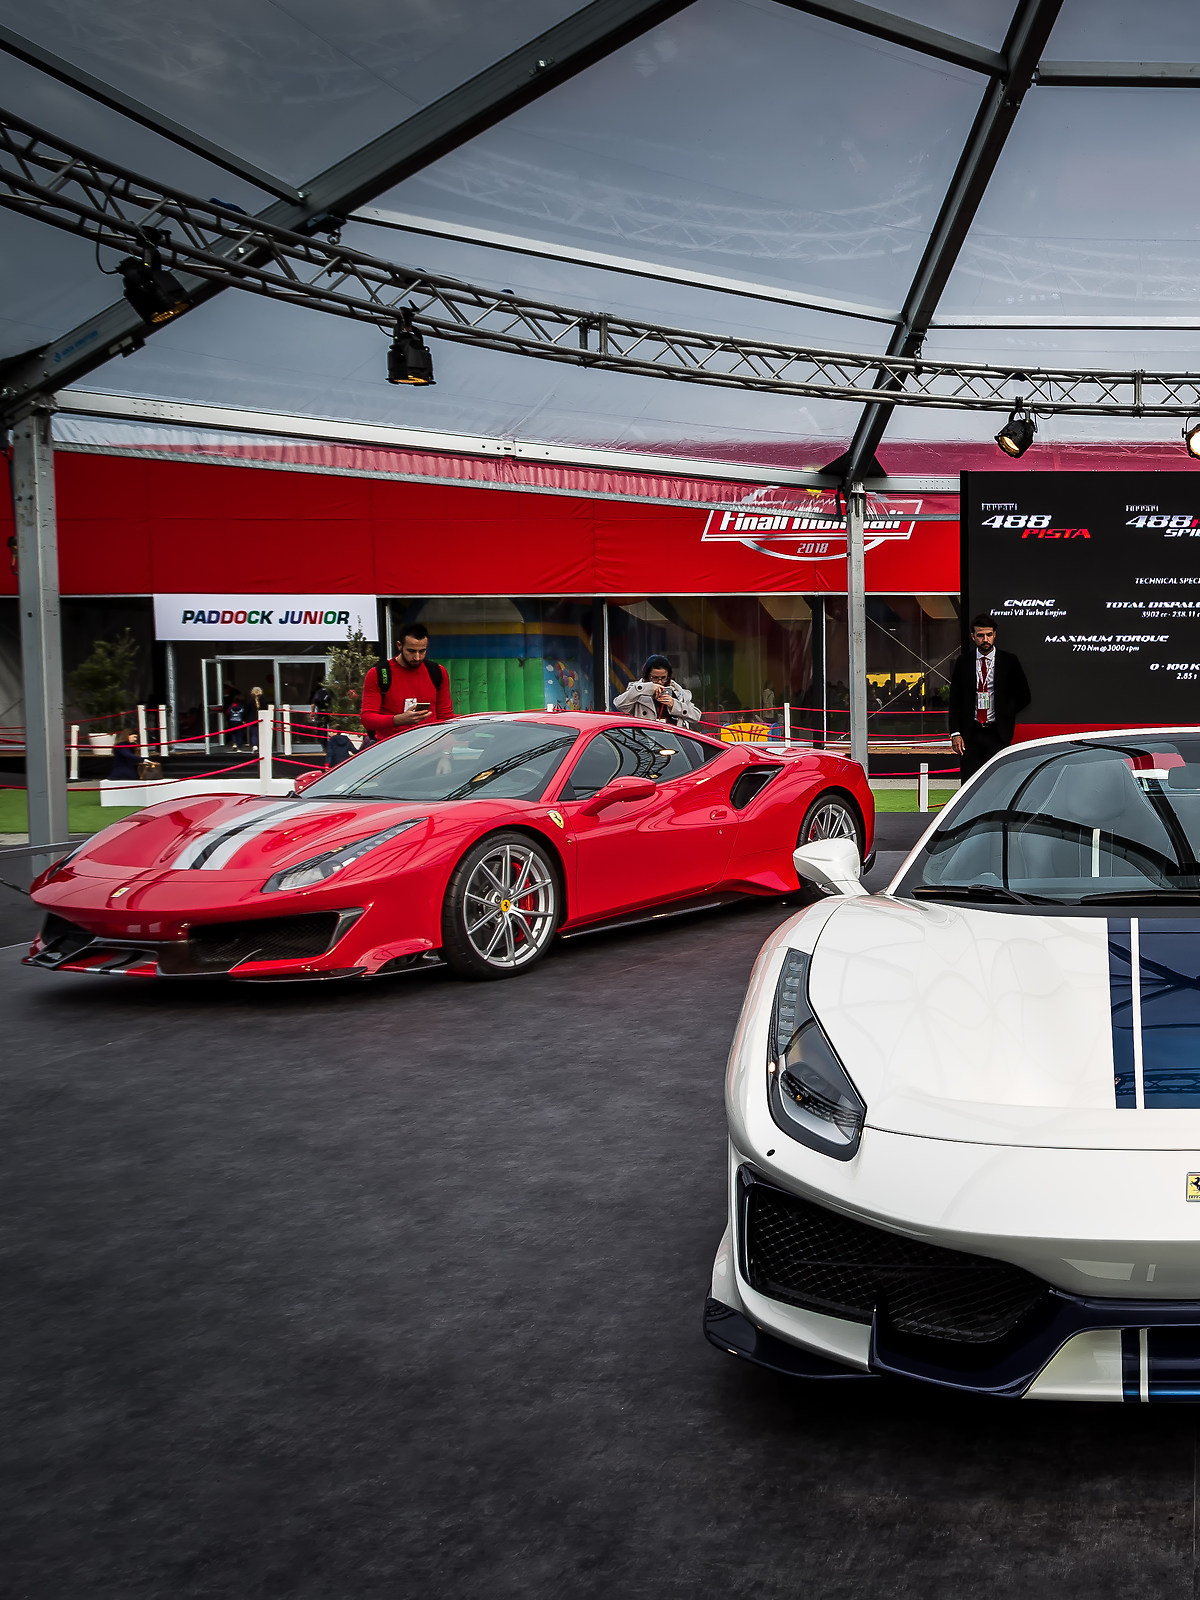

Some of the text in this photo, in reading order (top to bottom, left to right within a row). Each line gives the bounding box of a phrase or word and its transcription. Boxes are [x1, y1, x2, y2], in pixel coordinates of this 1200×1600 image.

[981, 514, 1052, 528] 488
[1021, 528, 1091, 539] PISTA
[797, 542, 829, 554] 2018
[1135, 577, 1178, 585] TECHNICAL
[1003, 599, 1056, 607] ENGINE
[1105, 601, 1146, 609] TOTAL
[181, 609, 350, 624] PADDOCK JUNIOR
[1045, 634, 1170, 642] MAXIMUM TORQUE
[1072, 644, 1087, 652] 770
[1166, 663, 1189, 671] 100
